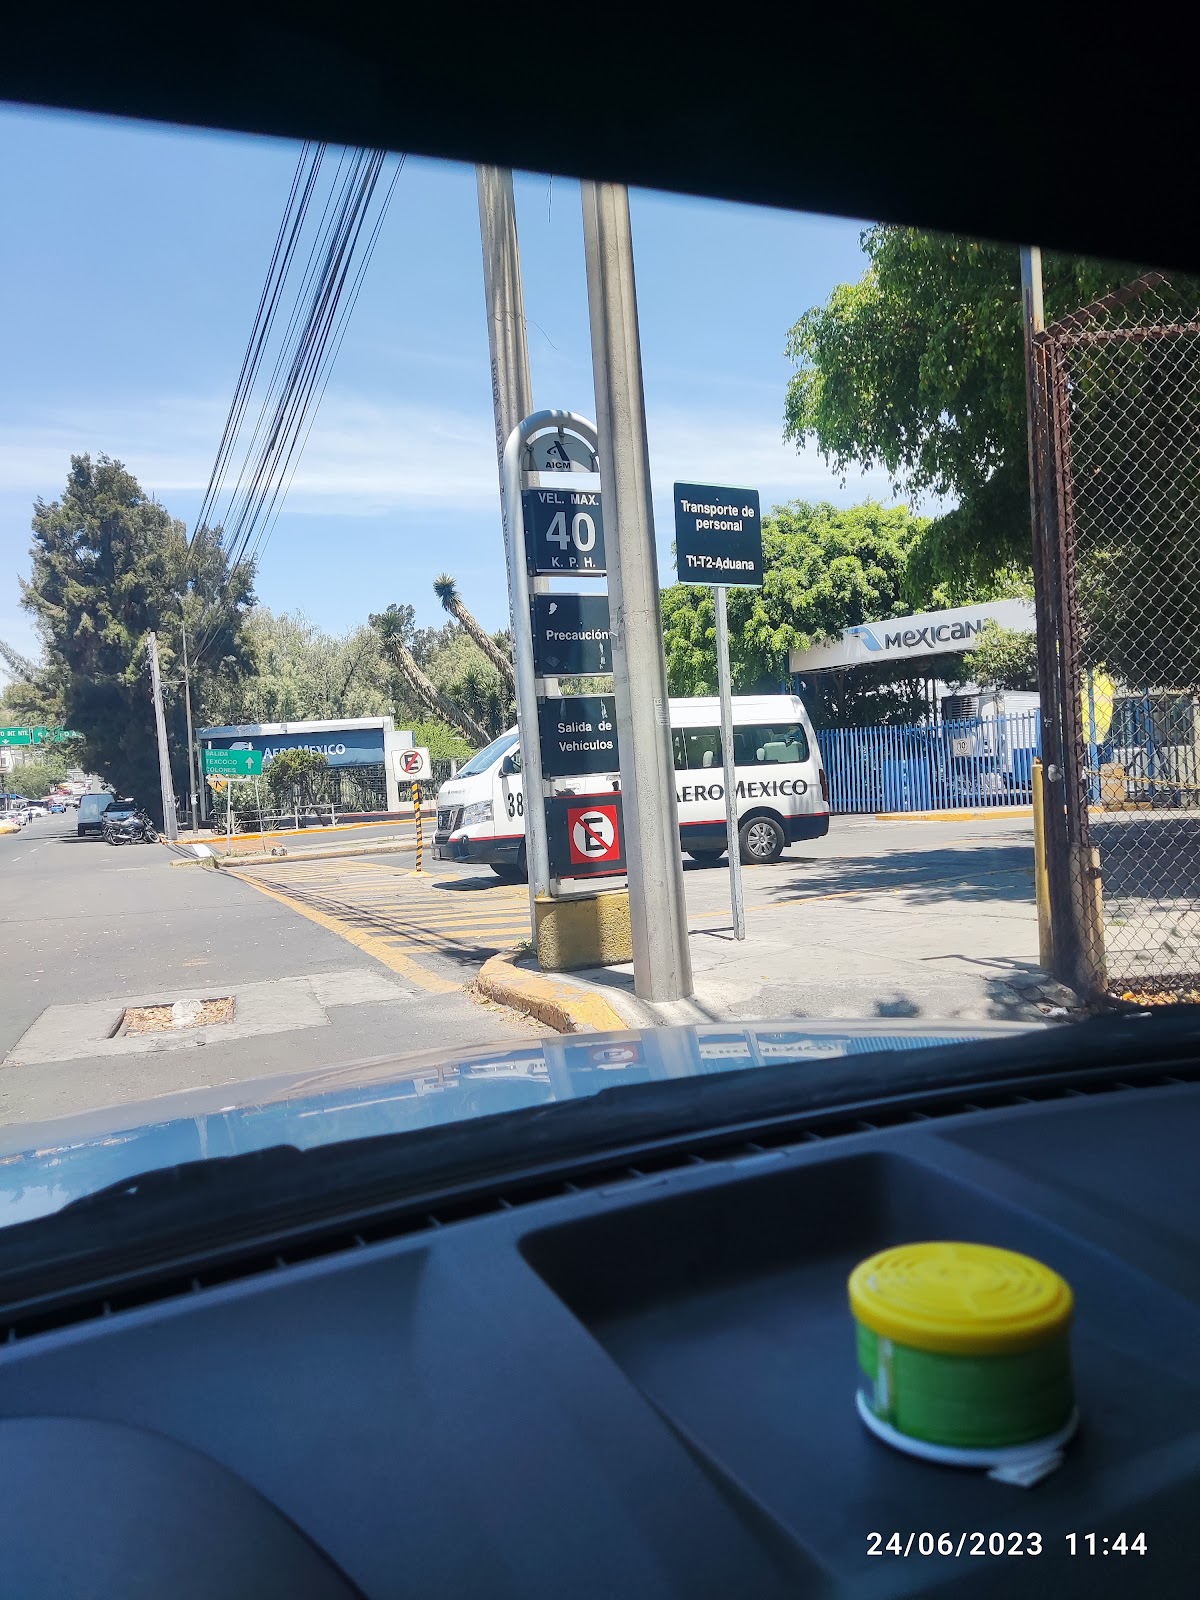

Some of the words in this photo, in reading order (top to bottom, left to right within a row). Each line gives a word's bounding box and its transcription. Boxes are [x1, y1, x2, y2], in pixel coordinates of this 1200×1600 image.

[545, 461, 571, 469] AICM
[538, 492, 565, 504] VEL.
[570, 493, 599, 506] MAX.
[680, 499, 739, 517] Transporte
[741, 505, 755, 518] de
[546, 511, 596, 552] 40
[695, 518, 743, 532] personal
[685, 554, 755, 571] T1-T2-Aduana
[546, 628, 609, 641] Precaución
[557, 721, 592, 734] Salida
[598, 720, 612, 731] de
[507, 792, 525, 818] 38
